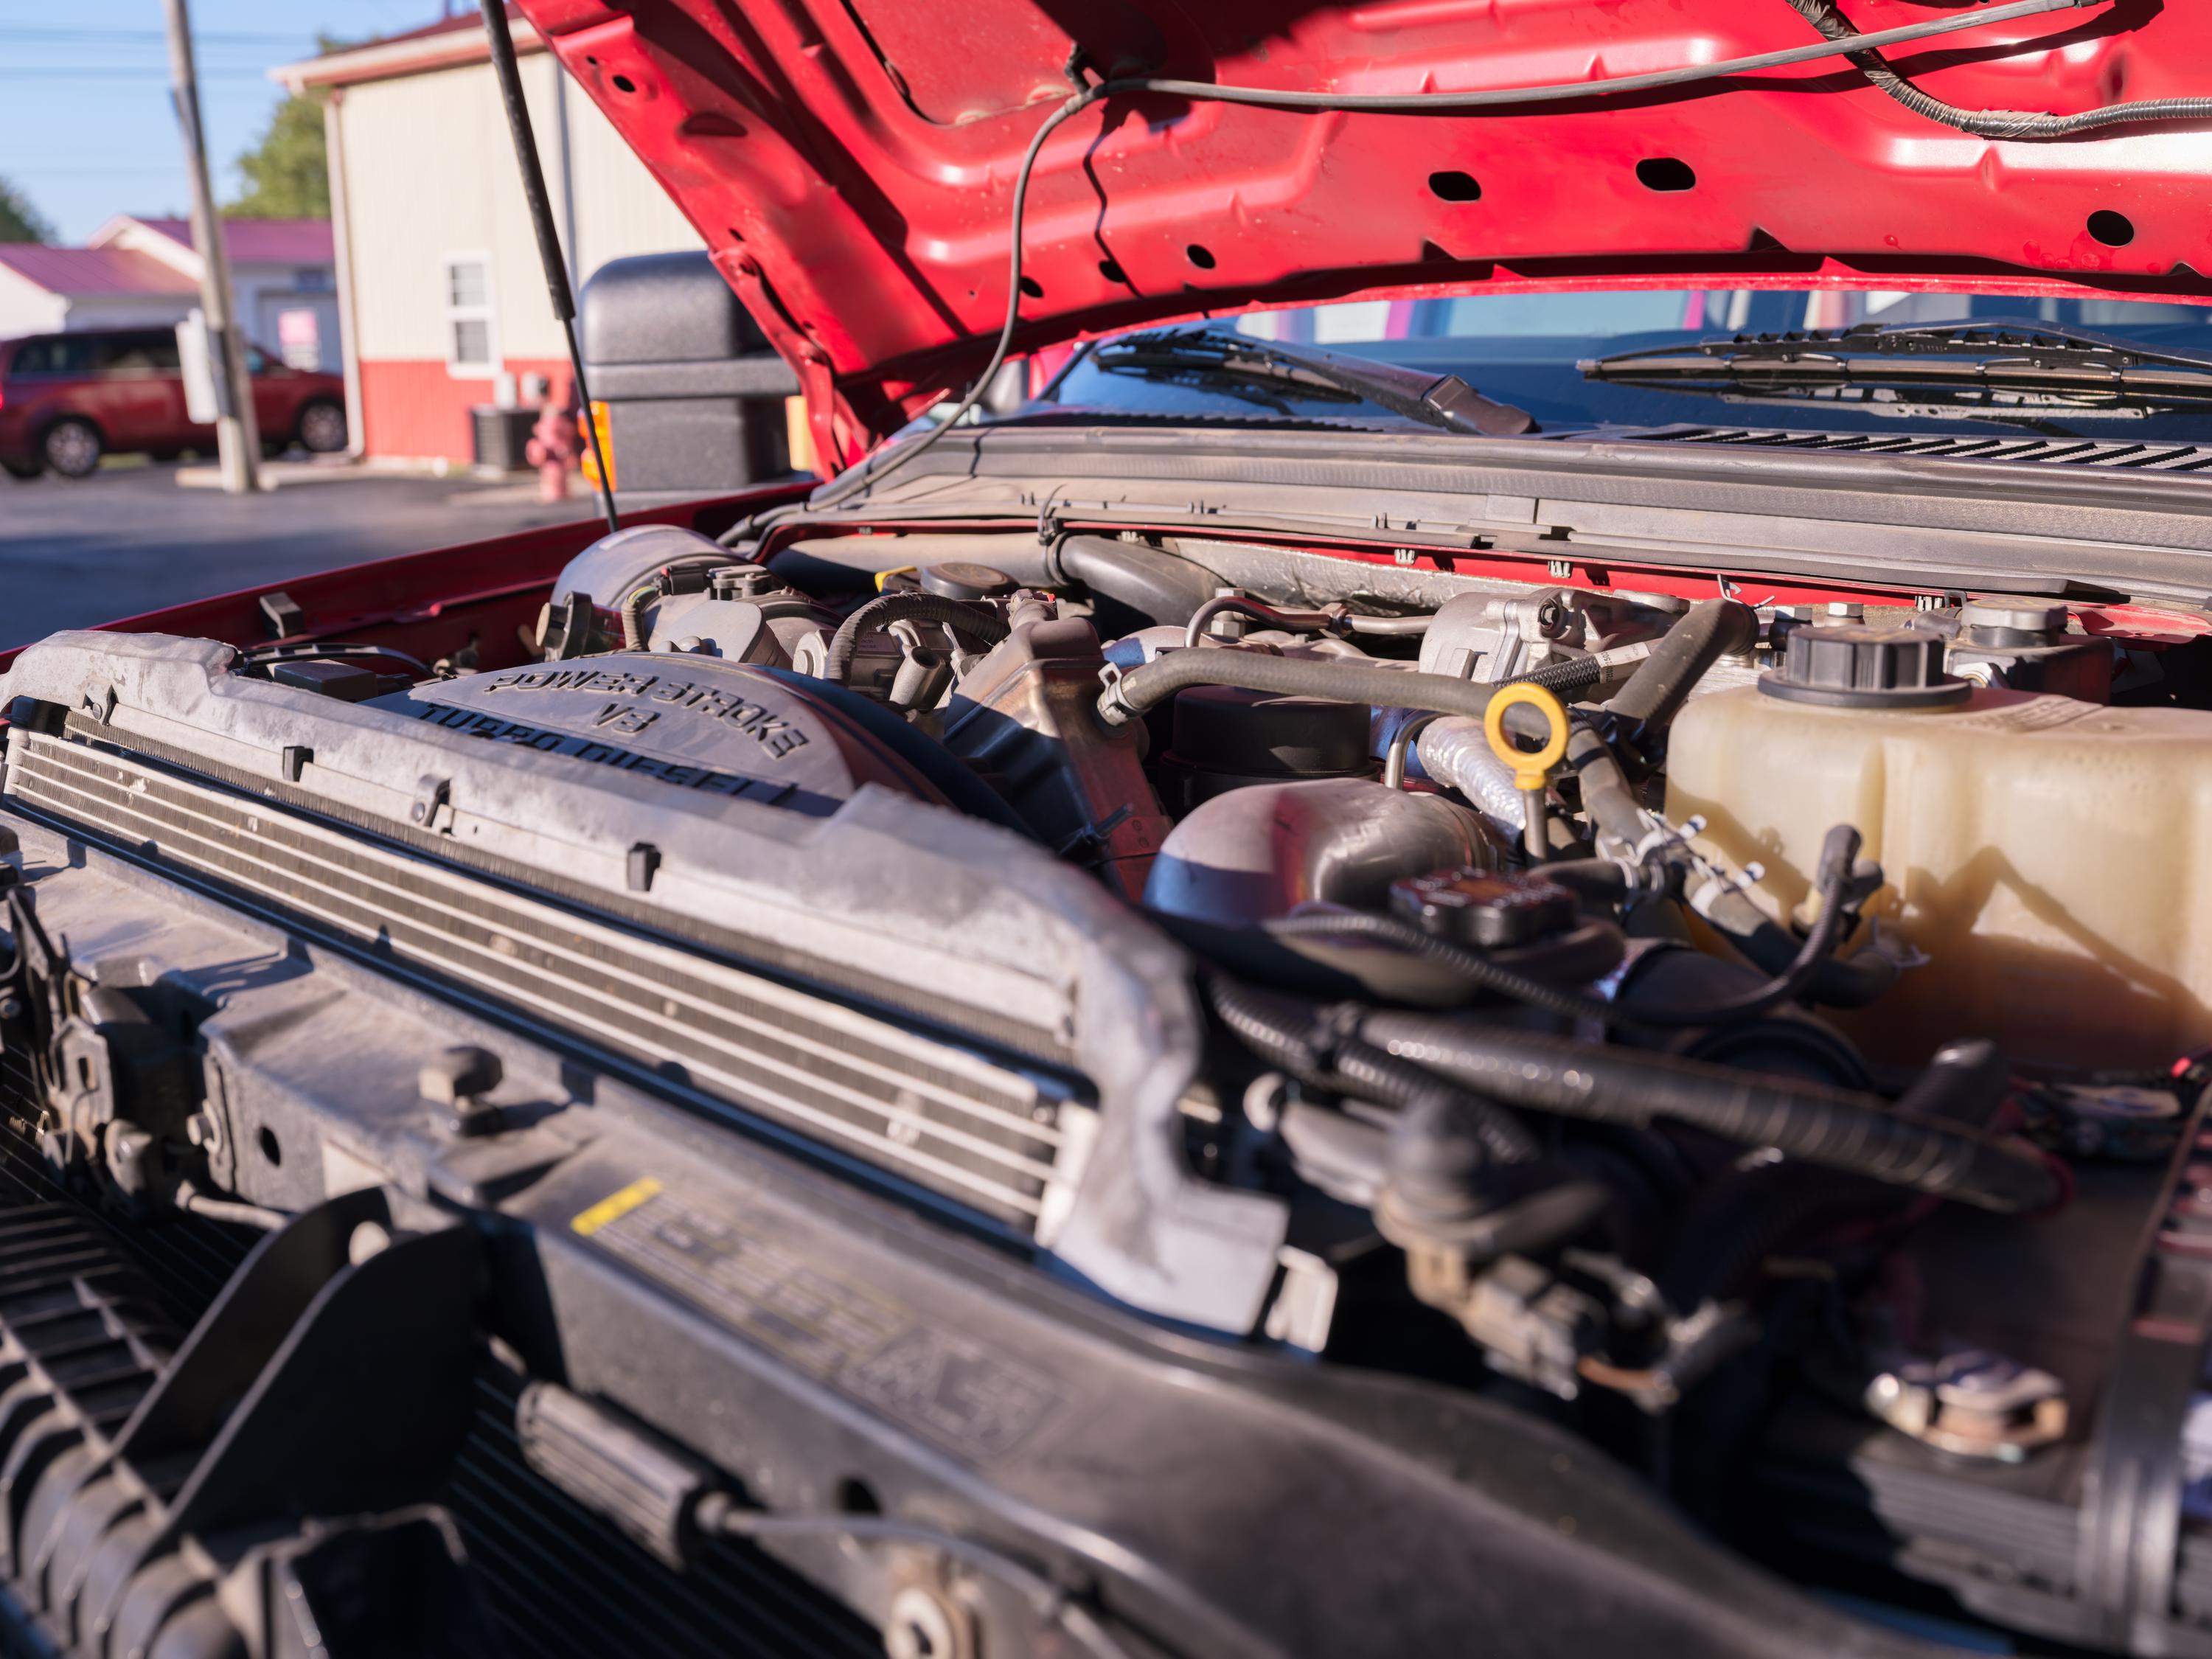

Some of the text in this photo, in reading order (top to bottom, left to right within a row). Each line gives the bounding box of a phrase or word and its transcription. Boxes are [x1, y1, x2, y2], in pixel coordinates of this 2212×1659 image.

[484, 669, 810, 761] POWER STROKE
[591, 702, 662, 734] V8
